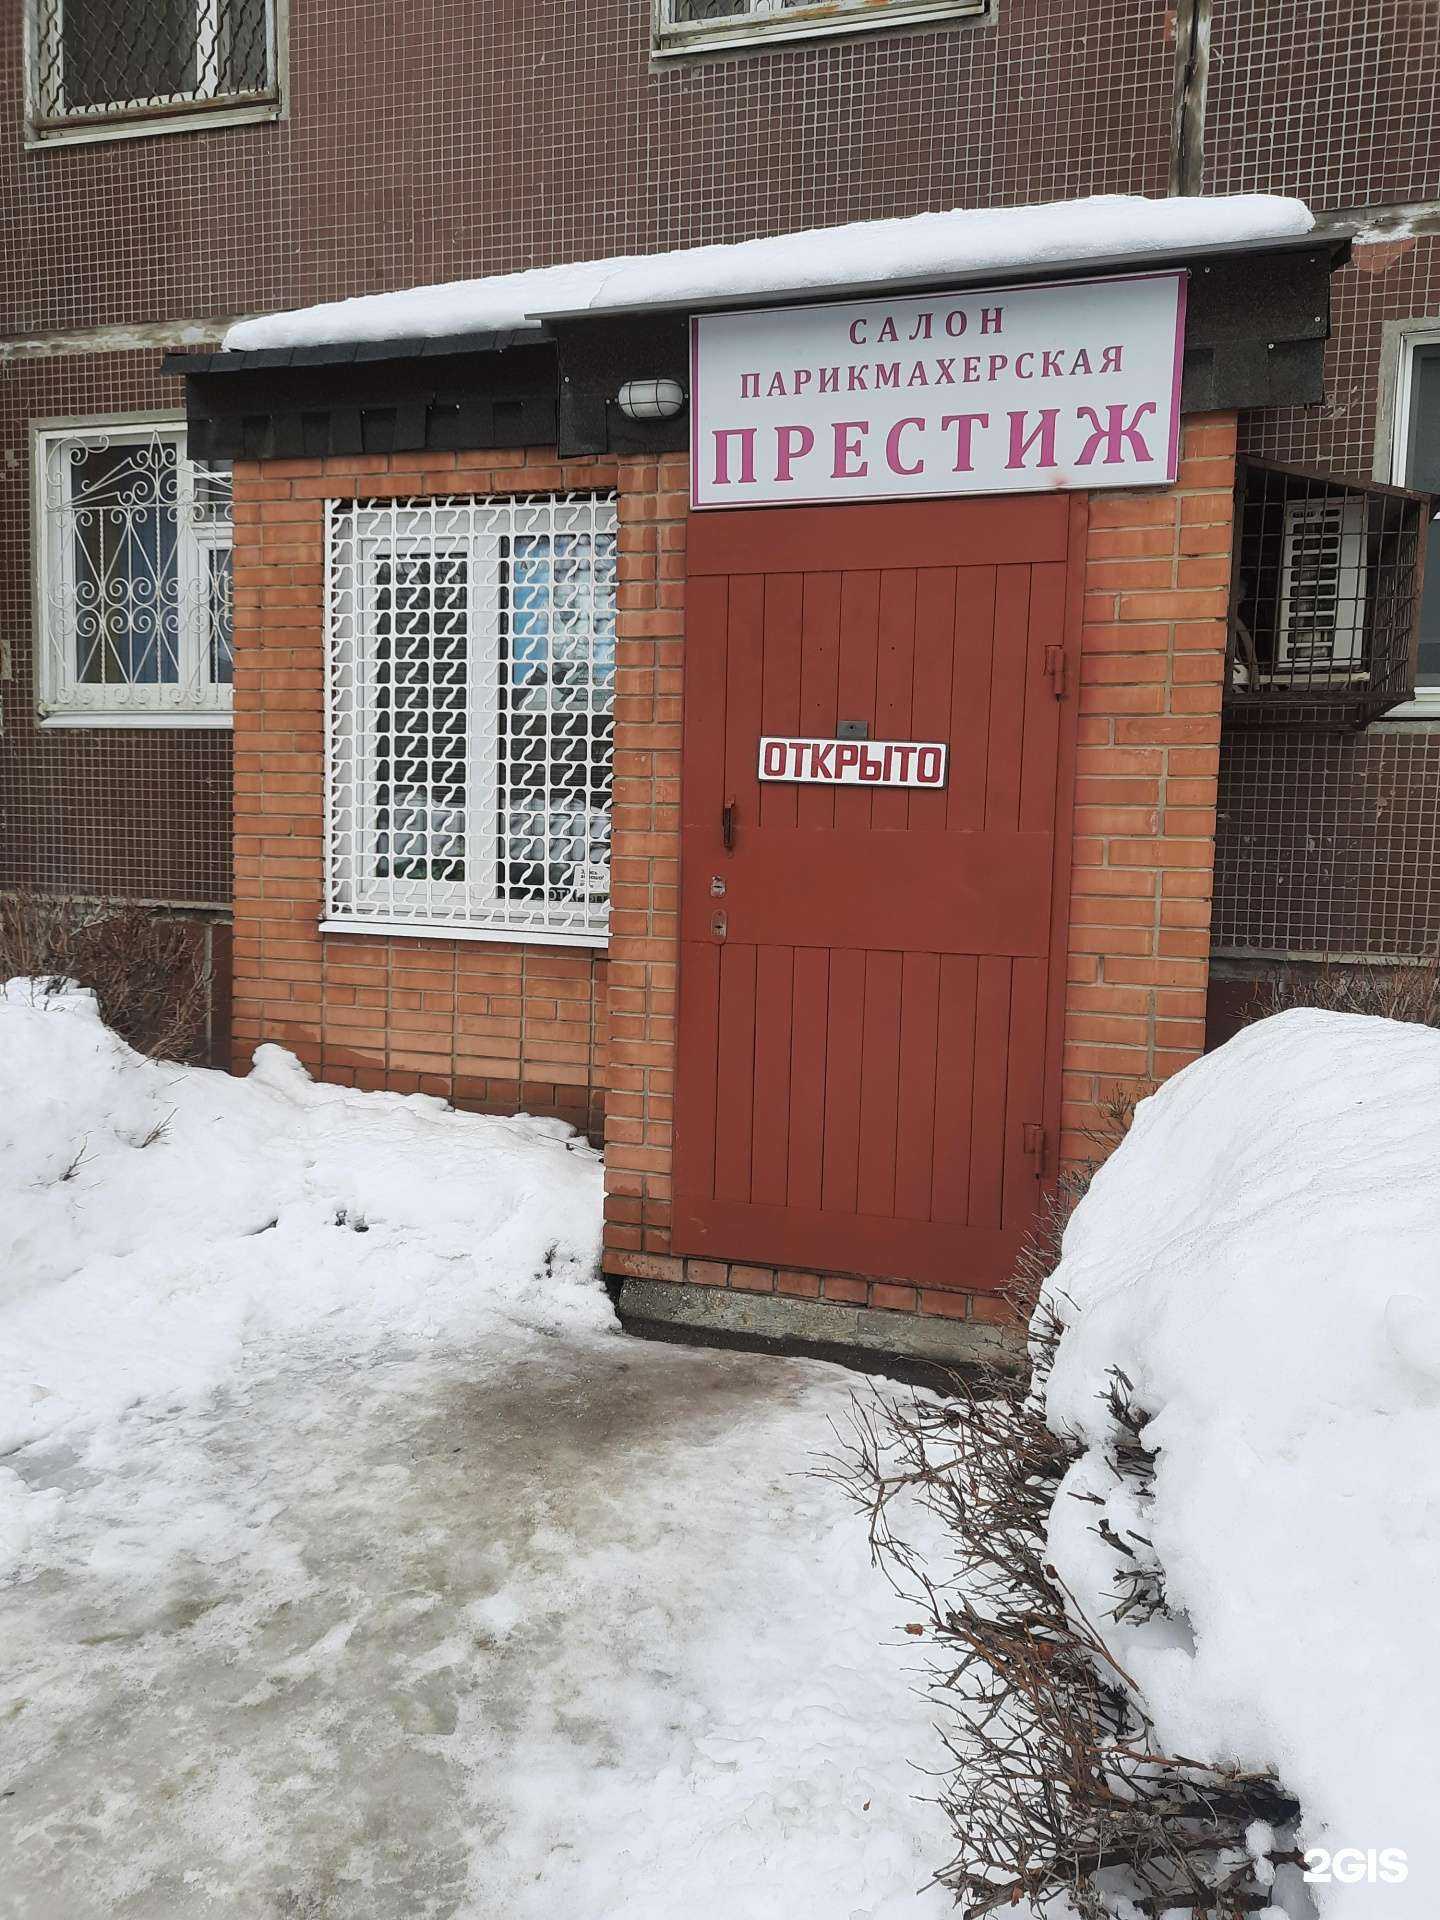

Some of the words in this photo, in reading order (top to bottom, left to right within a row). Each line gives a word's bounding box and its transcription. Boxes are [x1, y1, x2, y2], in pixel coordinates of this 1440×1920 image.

[848, 306, 1009, 345] САЛОН
[740, 345, 1125, 399] ПАРИКМАХЕРСКАЯ
[711, 401, 1158, 485] ПРЕСТИЖ
[763, 741, 942, 783] ОТКРЫТО
